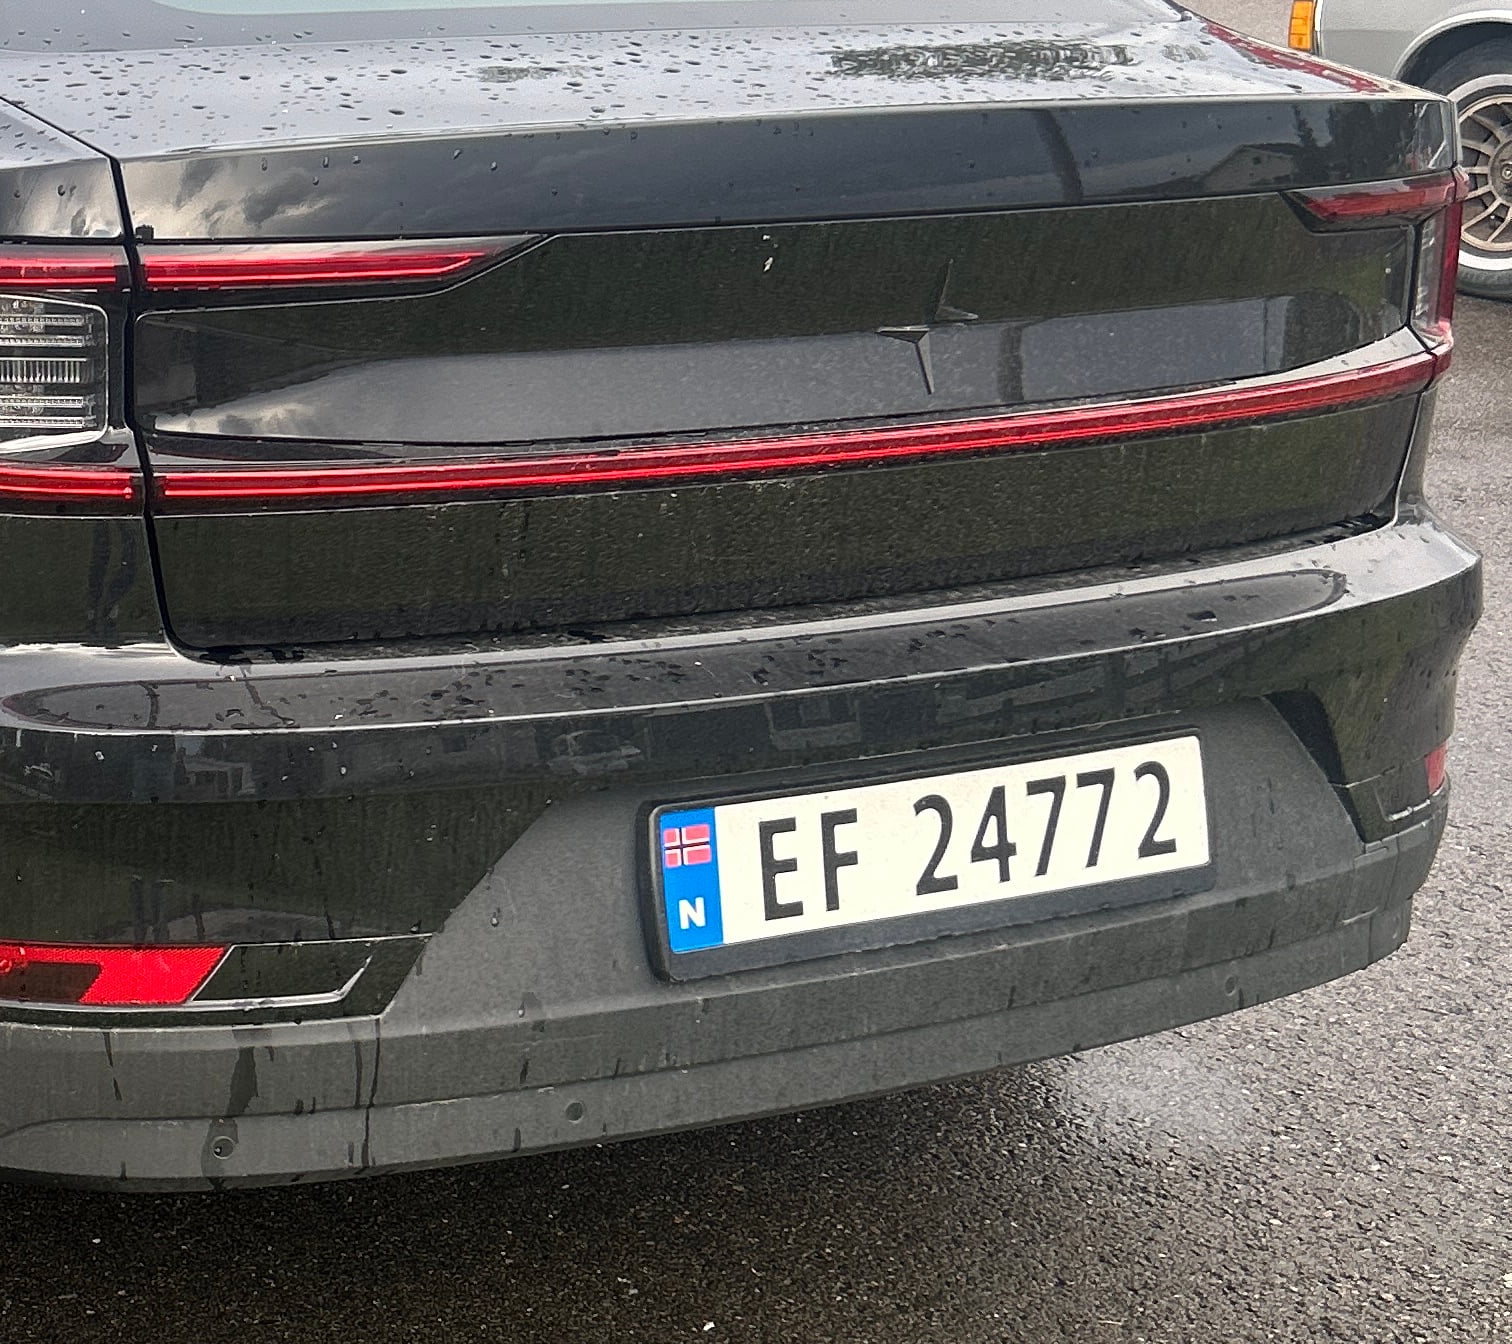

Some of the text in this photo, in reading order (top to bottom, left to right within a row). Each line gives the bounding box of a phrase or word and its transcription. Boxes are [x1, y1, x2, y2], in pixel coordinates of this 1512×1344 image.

[759, 760, 1177, 921] EF 24772
[678, 897, 705, 929] N
